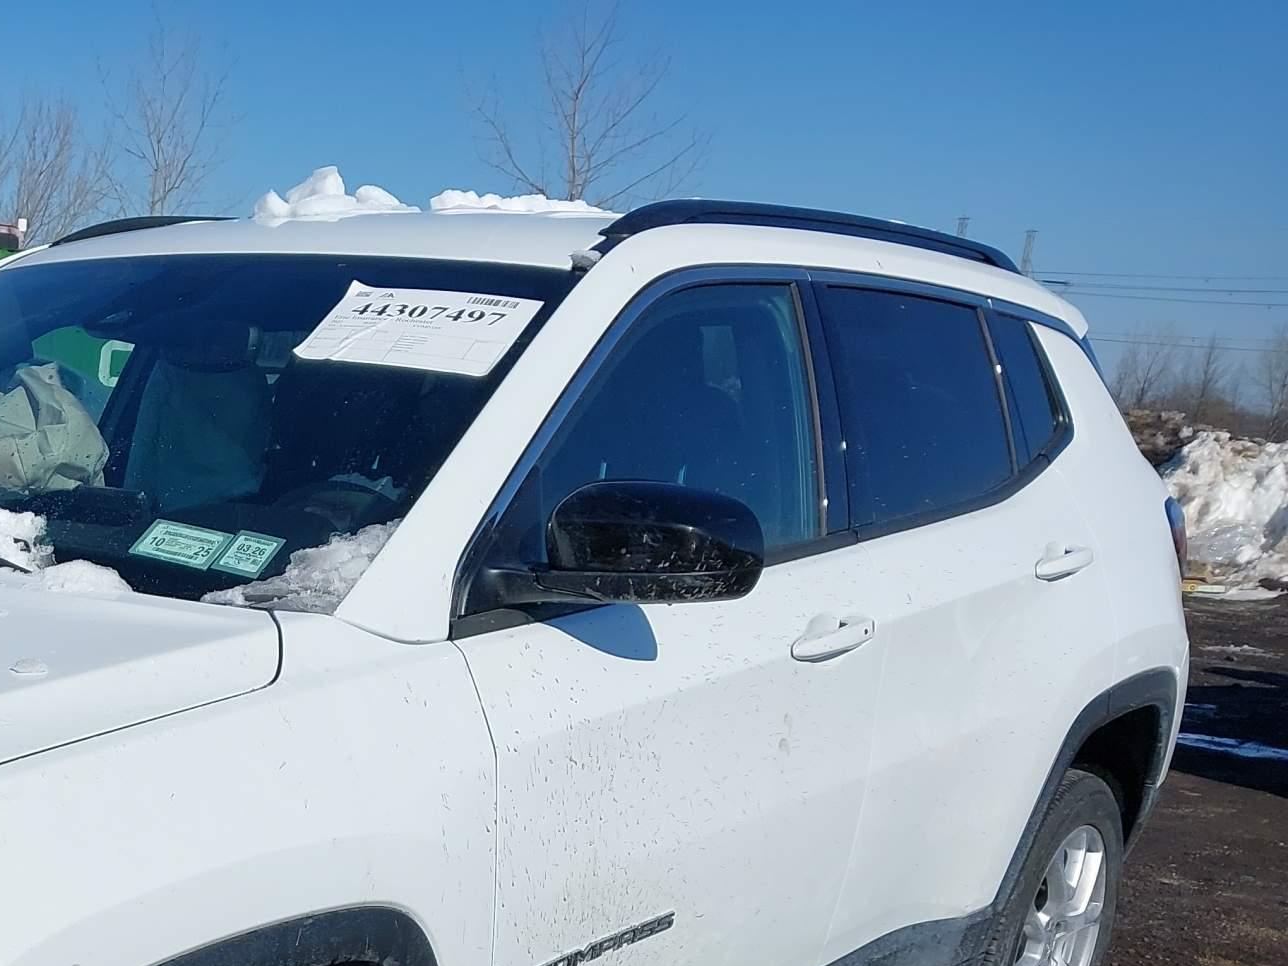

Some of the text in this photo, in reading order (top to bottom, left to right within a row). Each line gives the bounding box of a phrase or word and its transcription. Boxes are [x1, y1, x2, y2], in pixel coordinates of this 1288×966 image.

[352, 302, 507, 326] 44307497
[149, 536, 166, 547] 10
[193, 546, 213, 557] 25
